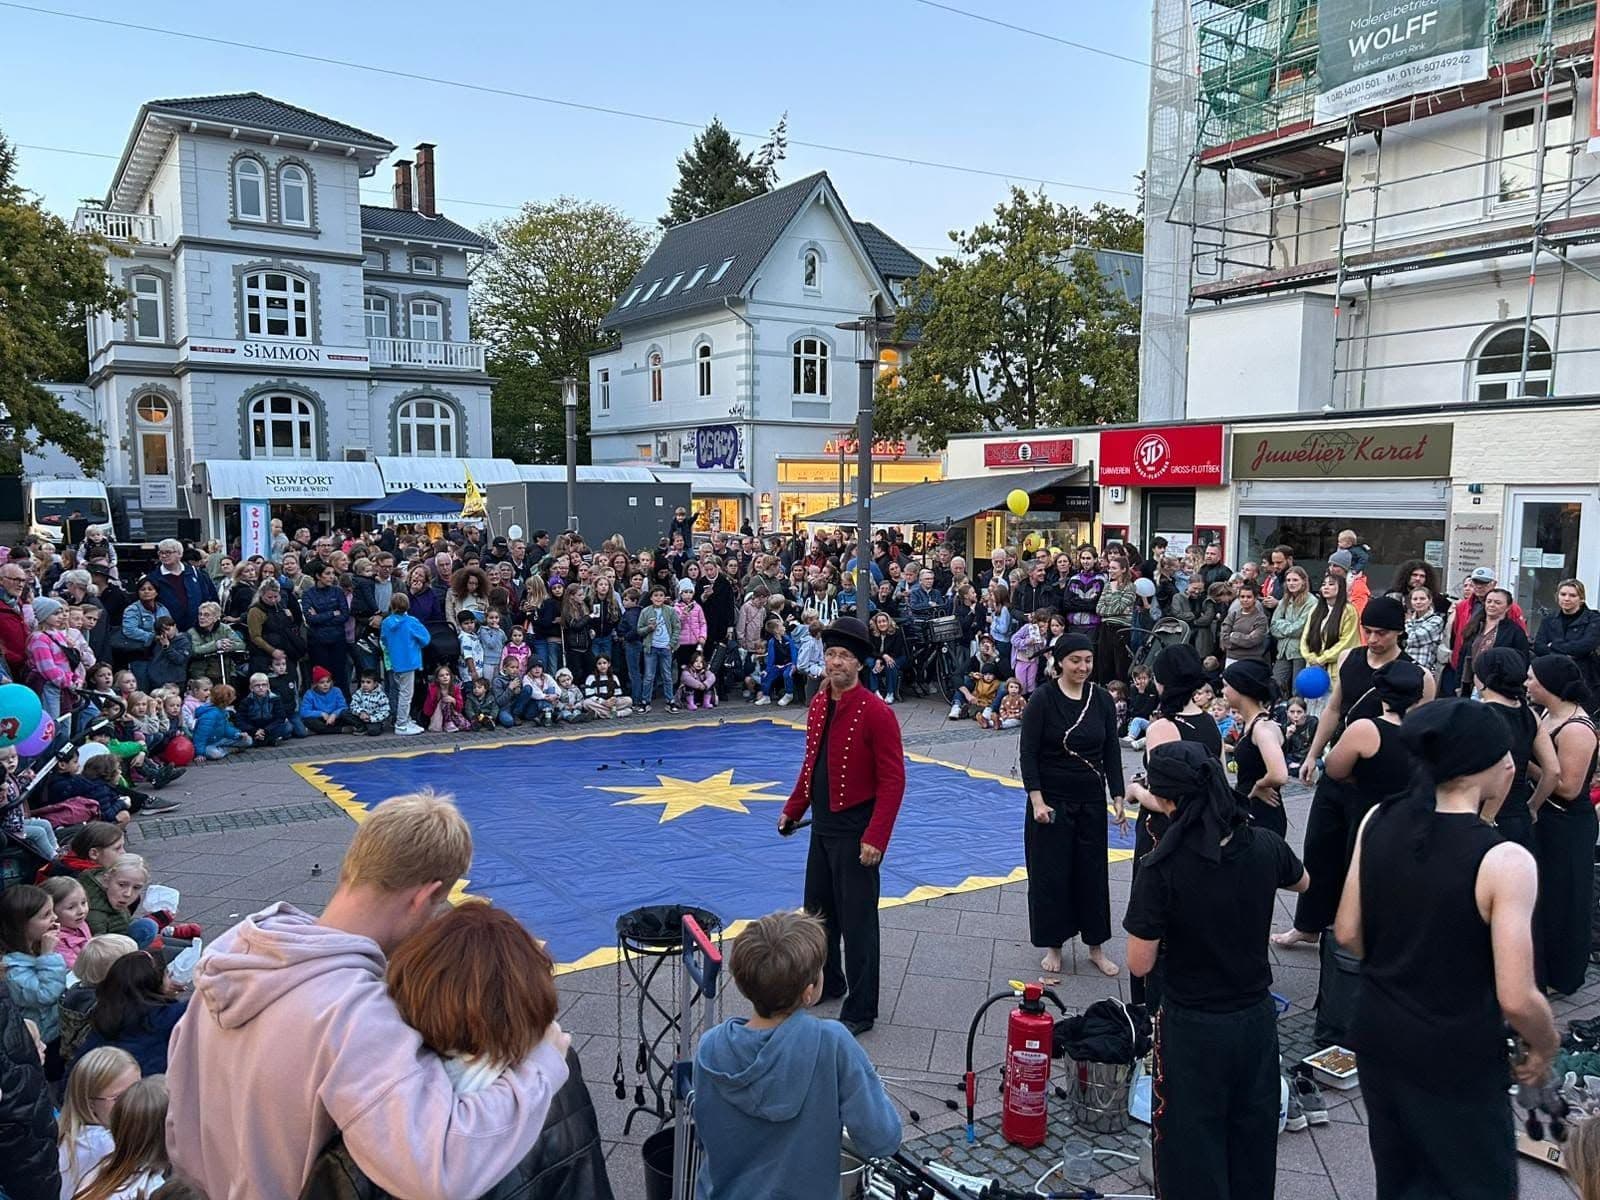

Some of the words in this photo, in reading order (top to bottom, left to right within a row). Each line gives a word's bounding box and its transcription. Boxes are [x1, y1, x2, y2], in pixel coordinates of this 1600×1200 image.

[1348, 10, 1438, 58] WOLFF
[1400, 55, 1471, 79] 0176-80749242
[824, 439, 906, 455] APOEKE
[1251, 437, 1346, 472] Juwelier
[1353, 433, 1429, 461] Karat
[1100, 466, 1131, 475] TURNVEREIN
[1170, 464, 1221, 475] GROSS-FLOTTBEK
[265, 475, 334, 485] NEWPORT
[1110, 488, 1119, 498] 19
